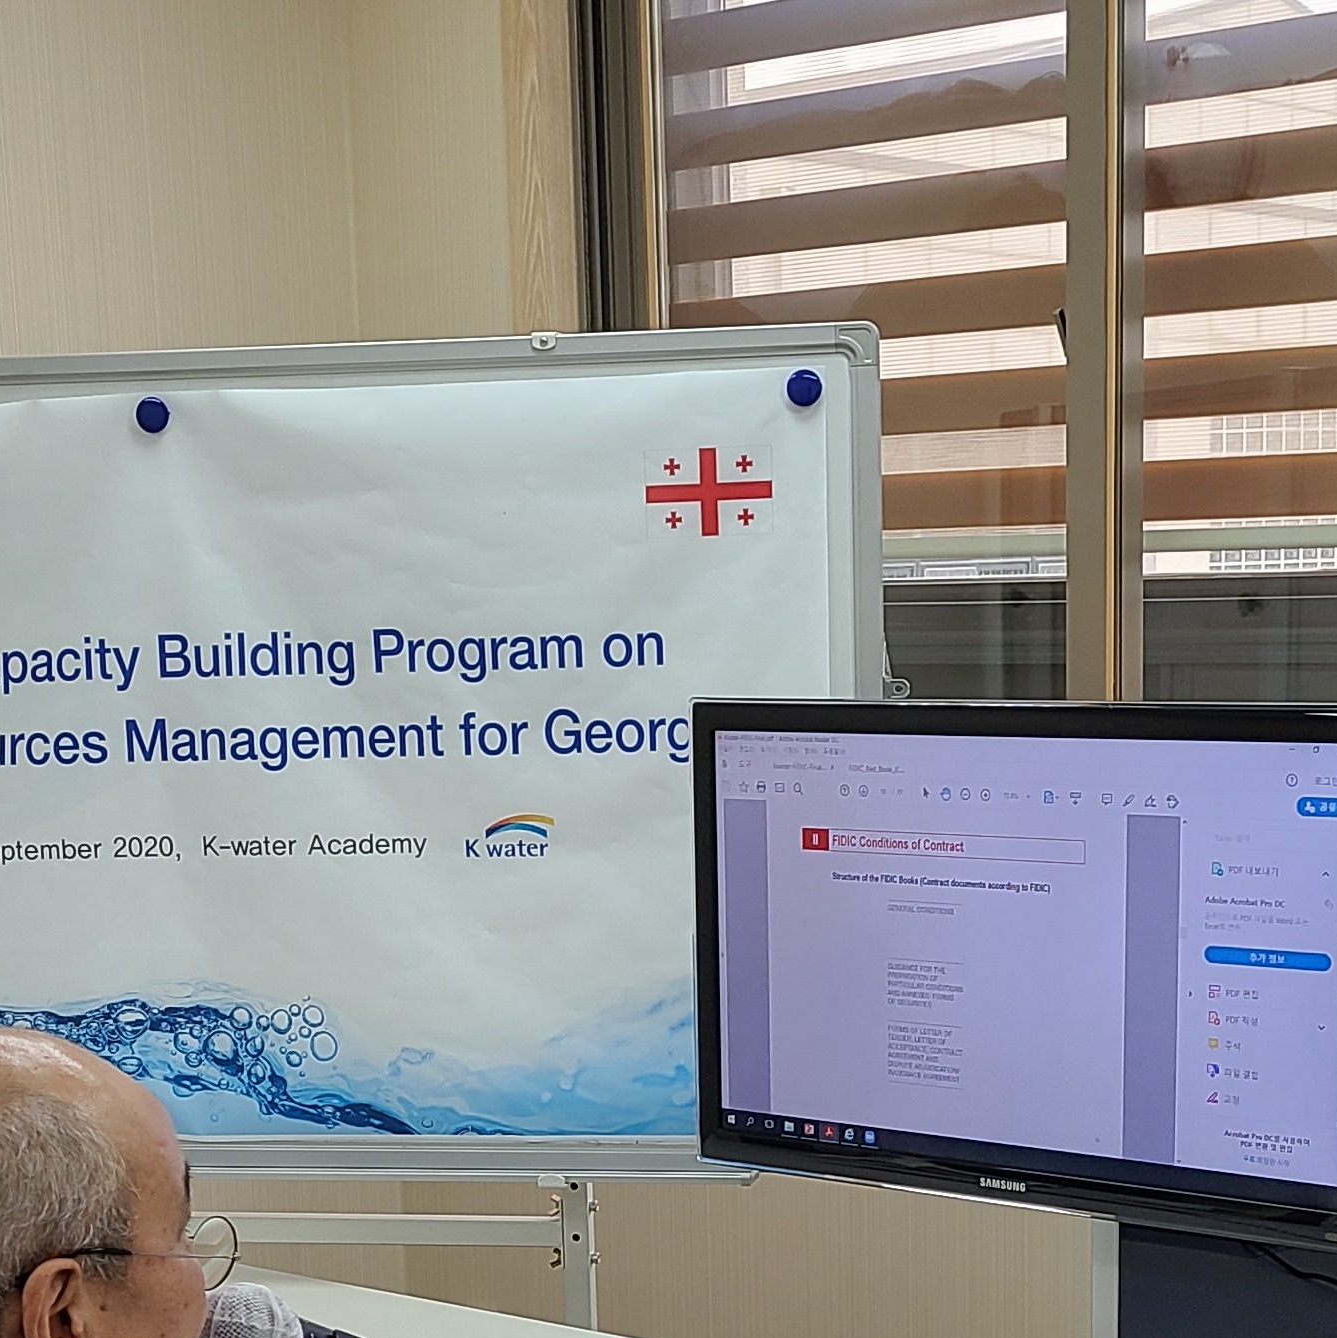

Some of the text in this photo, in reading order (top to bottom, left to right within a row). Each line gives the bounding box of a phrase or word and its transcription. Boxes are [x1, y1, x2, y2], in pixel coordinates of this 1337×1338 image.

[156, 630, 357, 687] Building
[371, 627, 585, 684] Program
[601, 630, 666, 669] on
[124, 714, 446, 772] Management
[458, 711, 530, 757] for
[111, 834, 183, 863] 2020,
[201, 832, 298, 859] K-water
[307, 830, 429, 860] Academy
[464, 838, 551, 859] K water
[831, 834, 965, 853] FIDIC Conditions of Contract
[1228, 866, 1243, 875] PDF
[831, 871, 860, 882] Structure
[869, 873, 879, 882] the
[880, 874, 898, 884] FIDIC
[898, 875, 919, 885] Books
[919, 877, 950, 888] (Contract
[950, 878, 986, 889] documents
[987, 880, 1020, 893] according
[1029, 883, 1051, 894] FIDIC)
[1204, 896, 1286, 909] Adobe Acrobat Pro DC
[1224, 1130, 1250, 1140] Acrobat
[979, 1177, 1026, 1193] SAMSUNG
